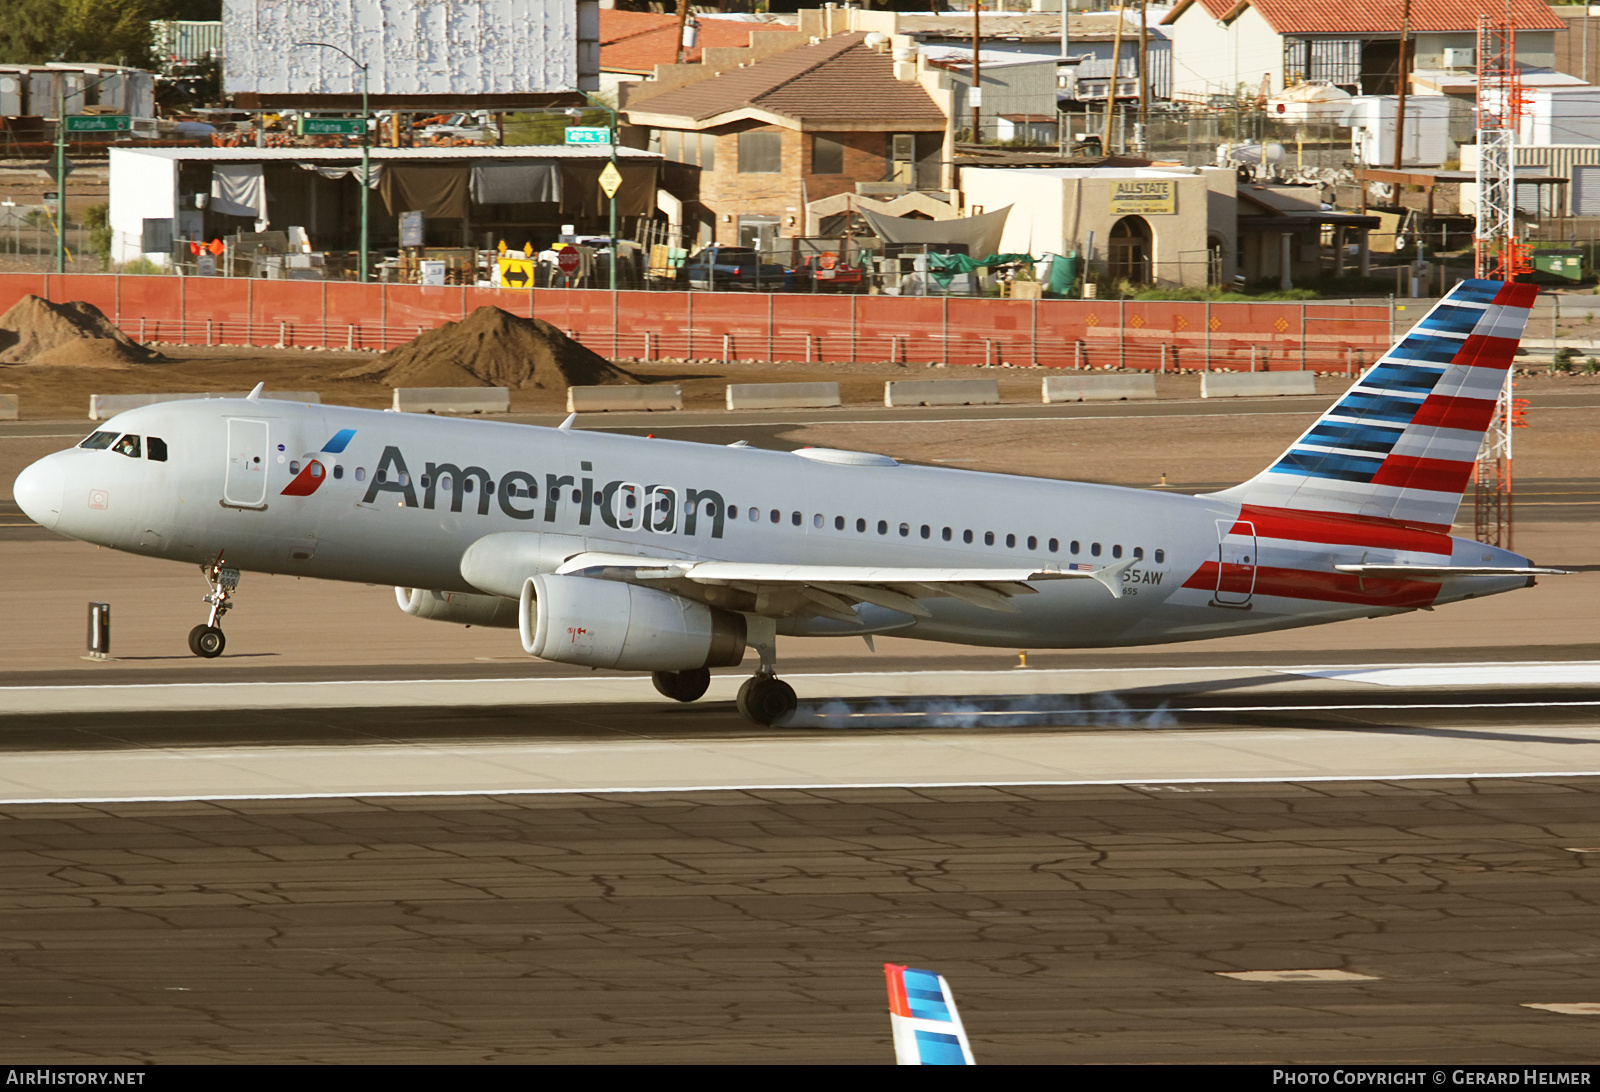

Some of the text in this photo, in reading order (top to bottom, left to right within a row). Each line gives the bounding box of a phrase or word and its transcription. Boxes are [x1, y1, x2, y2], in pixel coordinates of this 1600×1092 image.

[1117, 183, 1169, 194] ALLSTATE
[559, 254, 580, 265] STOP
[363, 445, 725, 539] American
[1122, 587, 1138, 595] 655
